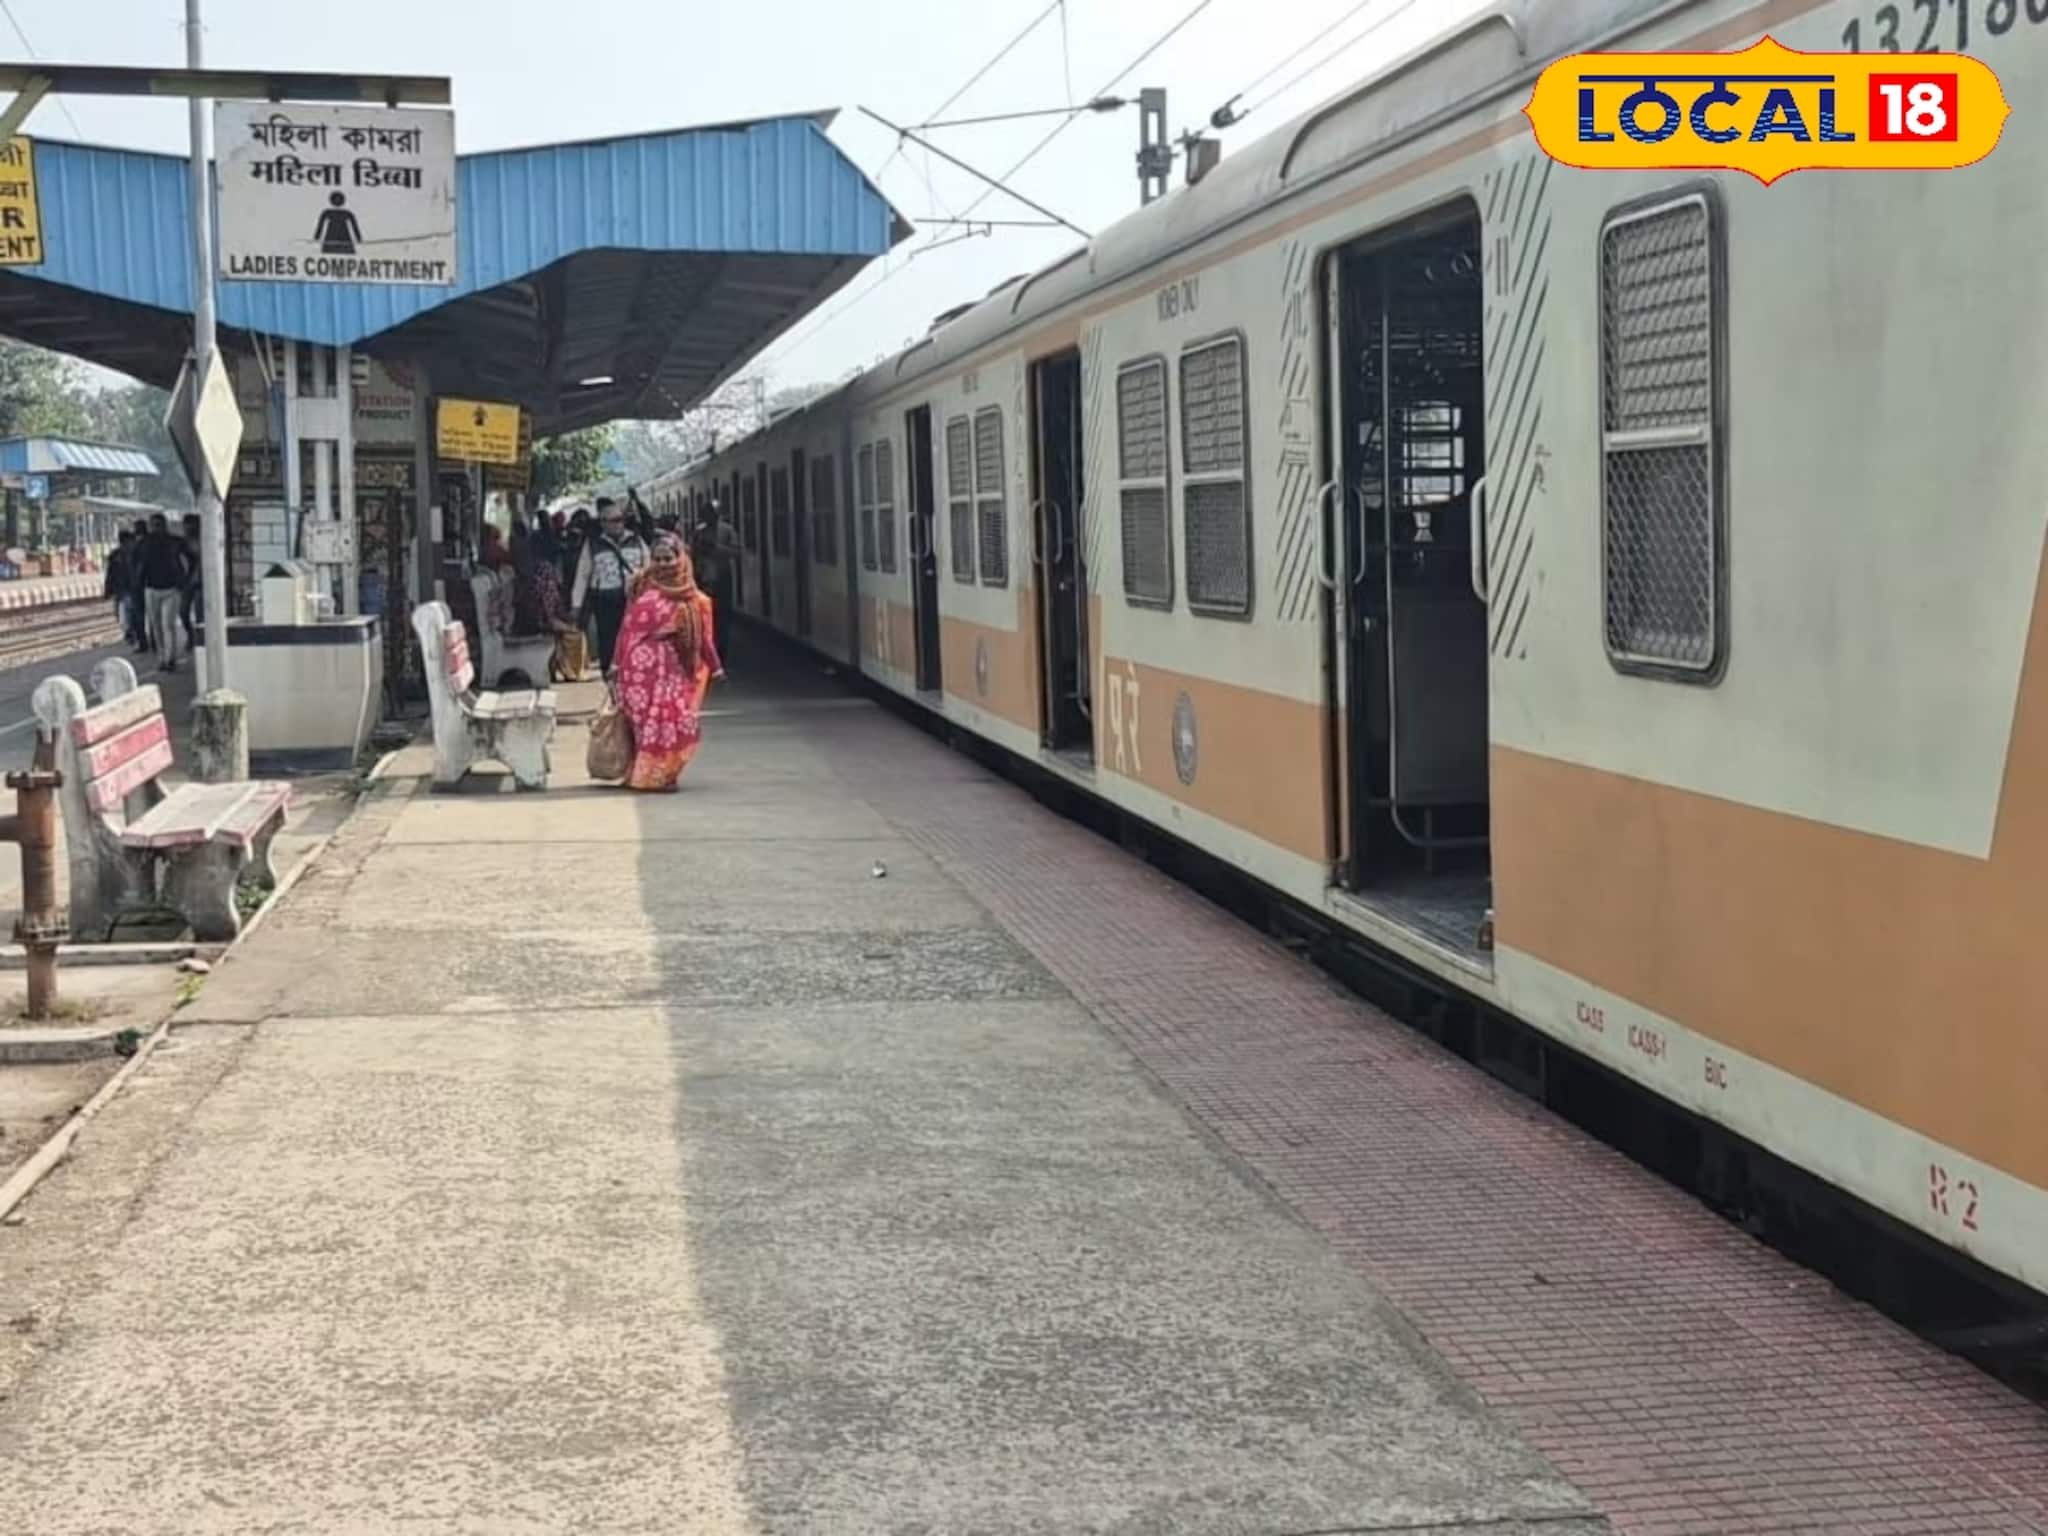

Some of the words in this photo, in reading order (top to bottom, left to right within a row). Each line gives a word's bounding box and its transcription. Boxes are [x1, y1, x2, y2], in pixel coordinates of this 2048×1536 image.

[248, 113, 329, 150] মহিলা
[339, 123, 422, 154] কামরা
[249, 154, 342, 186] महिला
[230, 255, 297, 275] LADIES
[304, 257, 446, 281] COMPARTMENT
